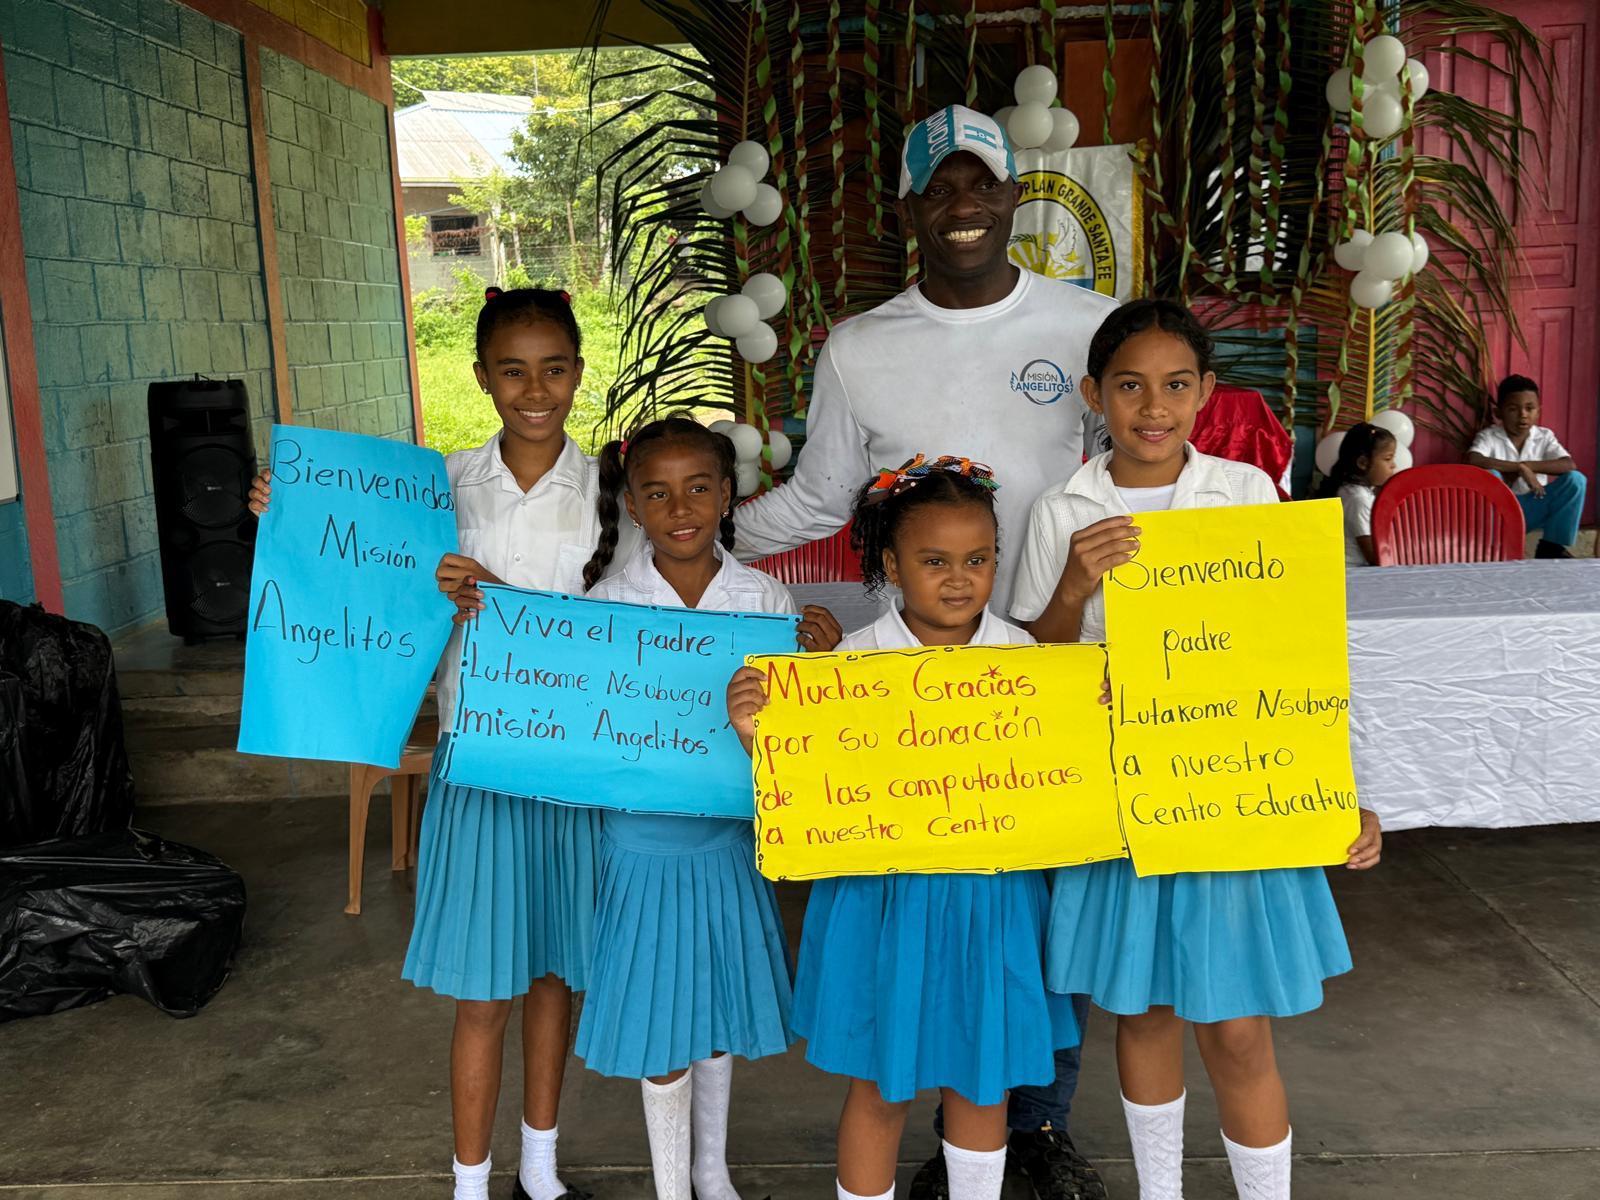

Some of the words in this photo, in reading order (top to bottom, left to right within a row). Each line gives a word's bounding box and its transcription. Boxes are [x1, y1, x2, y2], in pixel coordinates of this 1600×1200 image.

[1024, 179, 1056, 195] PLAN
[1058, 183, 1097, 224] GRANDE
[1088, 223, 1110, 264] SANTA
[1098, 265, 1112, 280] FE
[1015, 382, 1070, 393] ANGELITOS
[1027, 371, 1058, 382] MISIÓN
[271, 438, 454, 511] Bienvenidos
[319, 514, 416, 568] Misión
[1109, 535, 1284, 590] Bienvenido
[253, 580, 416, 663] Angelitos
[587, 614, 613, 643] el
[1163, 621, 1231, 680] padre
[470, 642, 589, 691] Lutakome
[606, 671, 712, 716] Nsubuga
[766, 661, 890, 706] Muchas
[912, 657, 1036, 701] Gracias
[1119, 684, 1238, 726] Lutakome
[763, 735, 814, 774] por
[897, 706, 1042, 747] donación
[1122, 754, 1142, 776] a
[1171, 741, 1294, 777] nuestro
[761, 780, 793, 811] de
[825, 773, 871, 805] las
[1131, 792, 1222, 826] Centro
[1236, 778, 1357, 817] Educativo
[765, 826, 785, 845] a
[806, 814, 904, 845] nuestro
